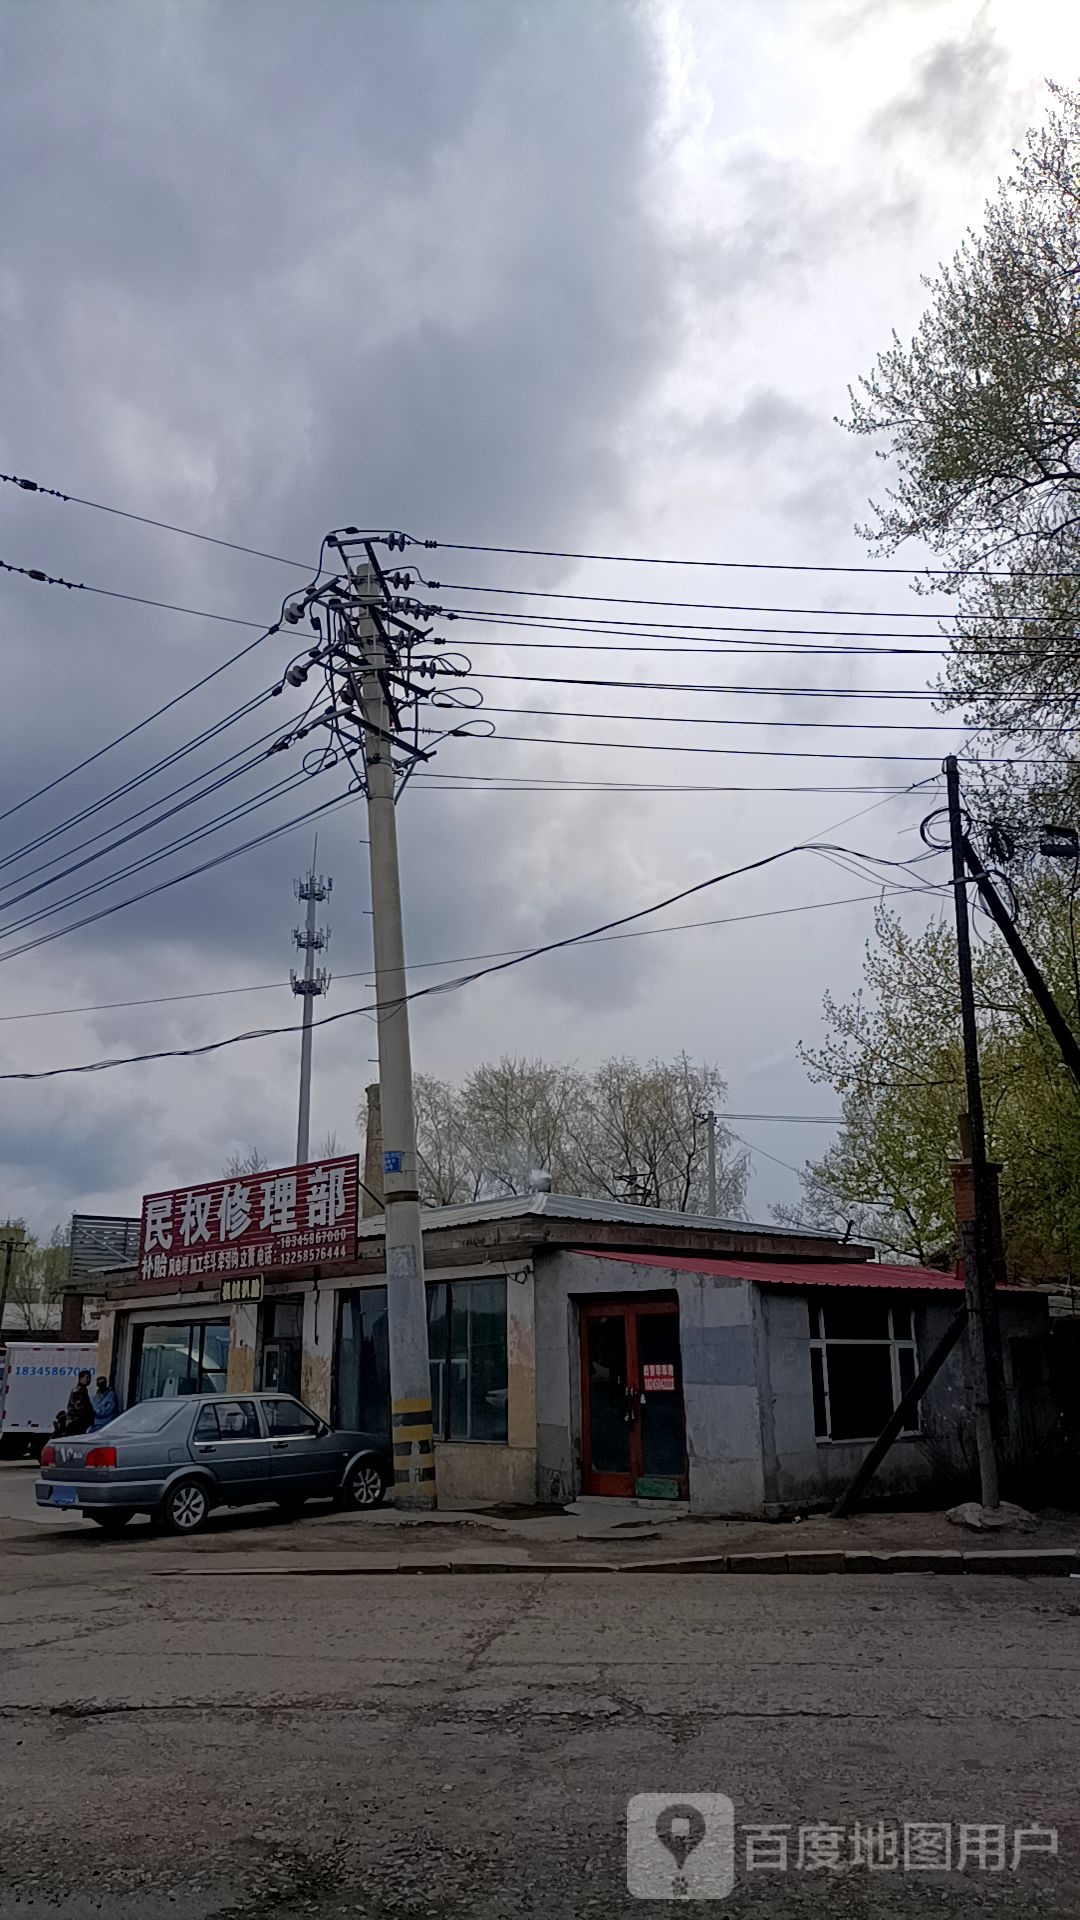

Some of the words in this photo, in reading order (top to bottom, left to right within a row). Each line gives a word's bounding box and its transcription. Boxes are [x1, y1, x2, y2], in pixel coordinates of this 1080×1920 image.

[144, 1166, 346, 1252] 民权修理部
[15, 1366, 96, 1376] 1834586700
